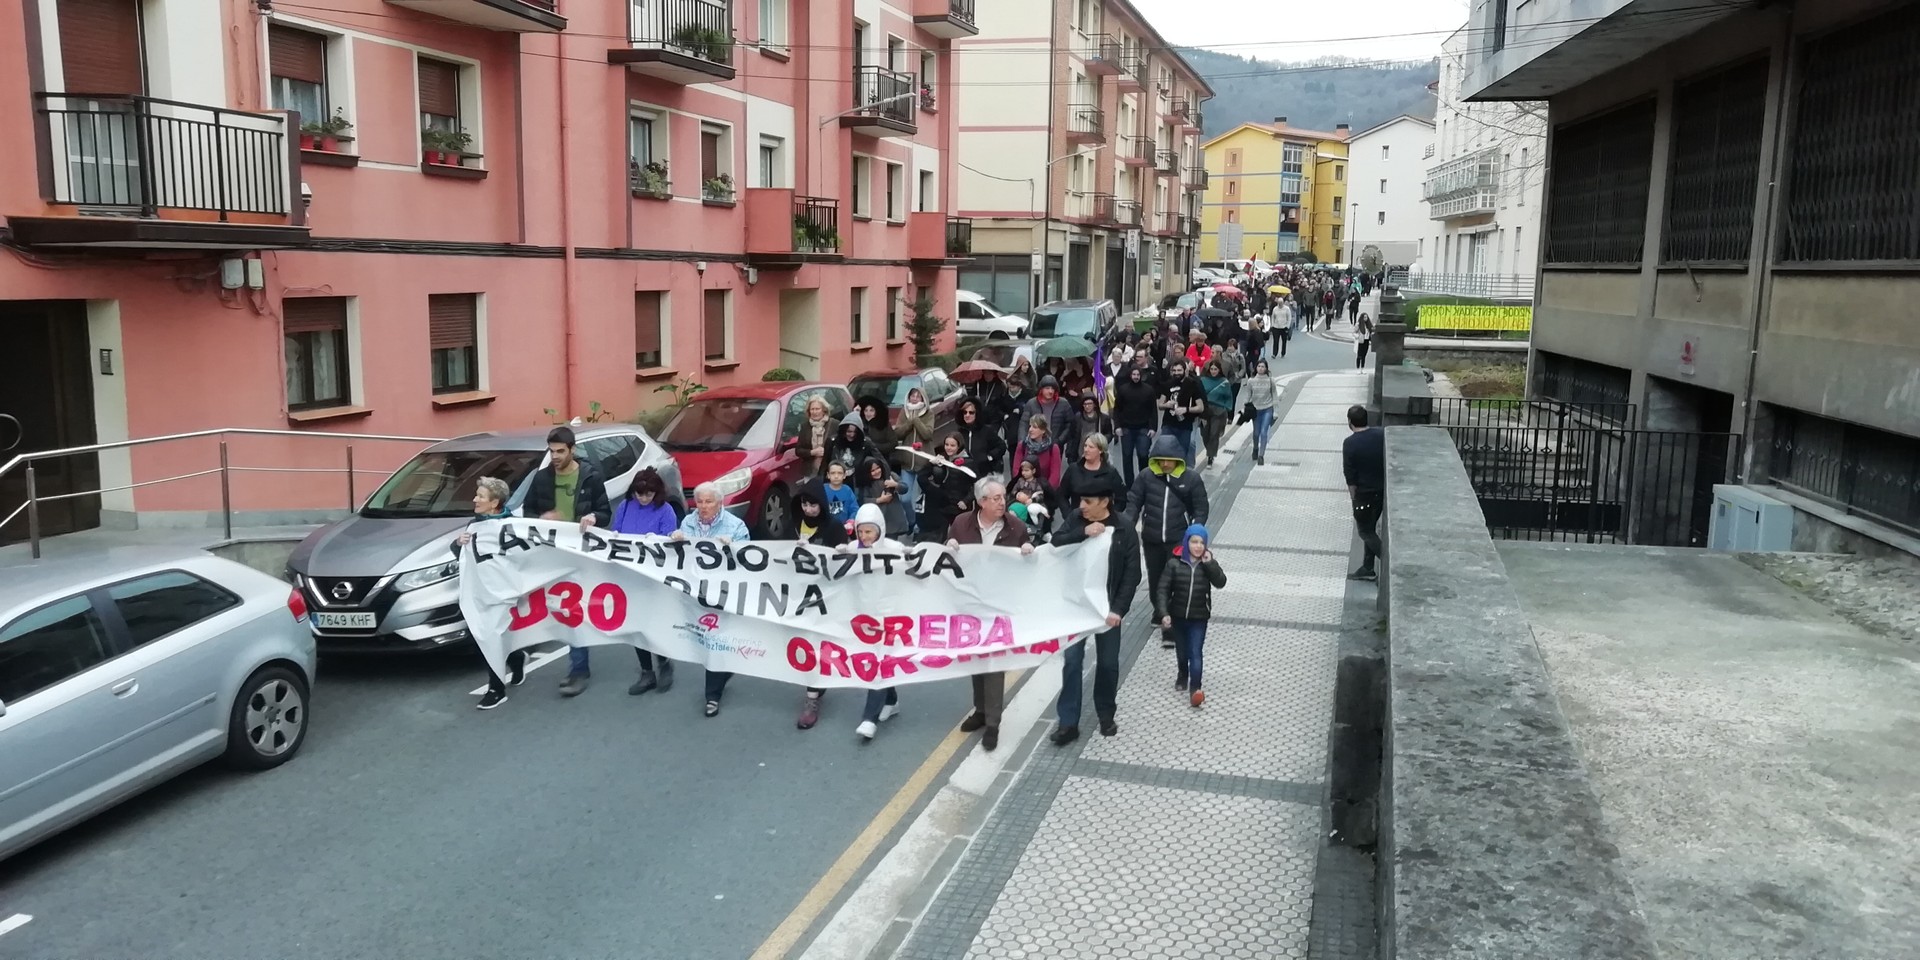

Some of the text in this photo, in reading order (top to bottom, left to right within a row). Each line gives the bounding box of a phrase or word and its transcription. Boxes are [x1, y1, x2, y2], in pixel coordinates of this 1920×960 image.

[472, 523, 557, 564] LAN
[319, 614, 371, 626] 7649 KHF
[850, 613, 1015, 649] GREBA
